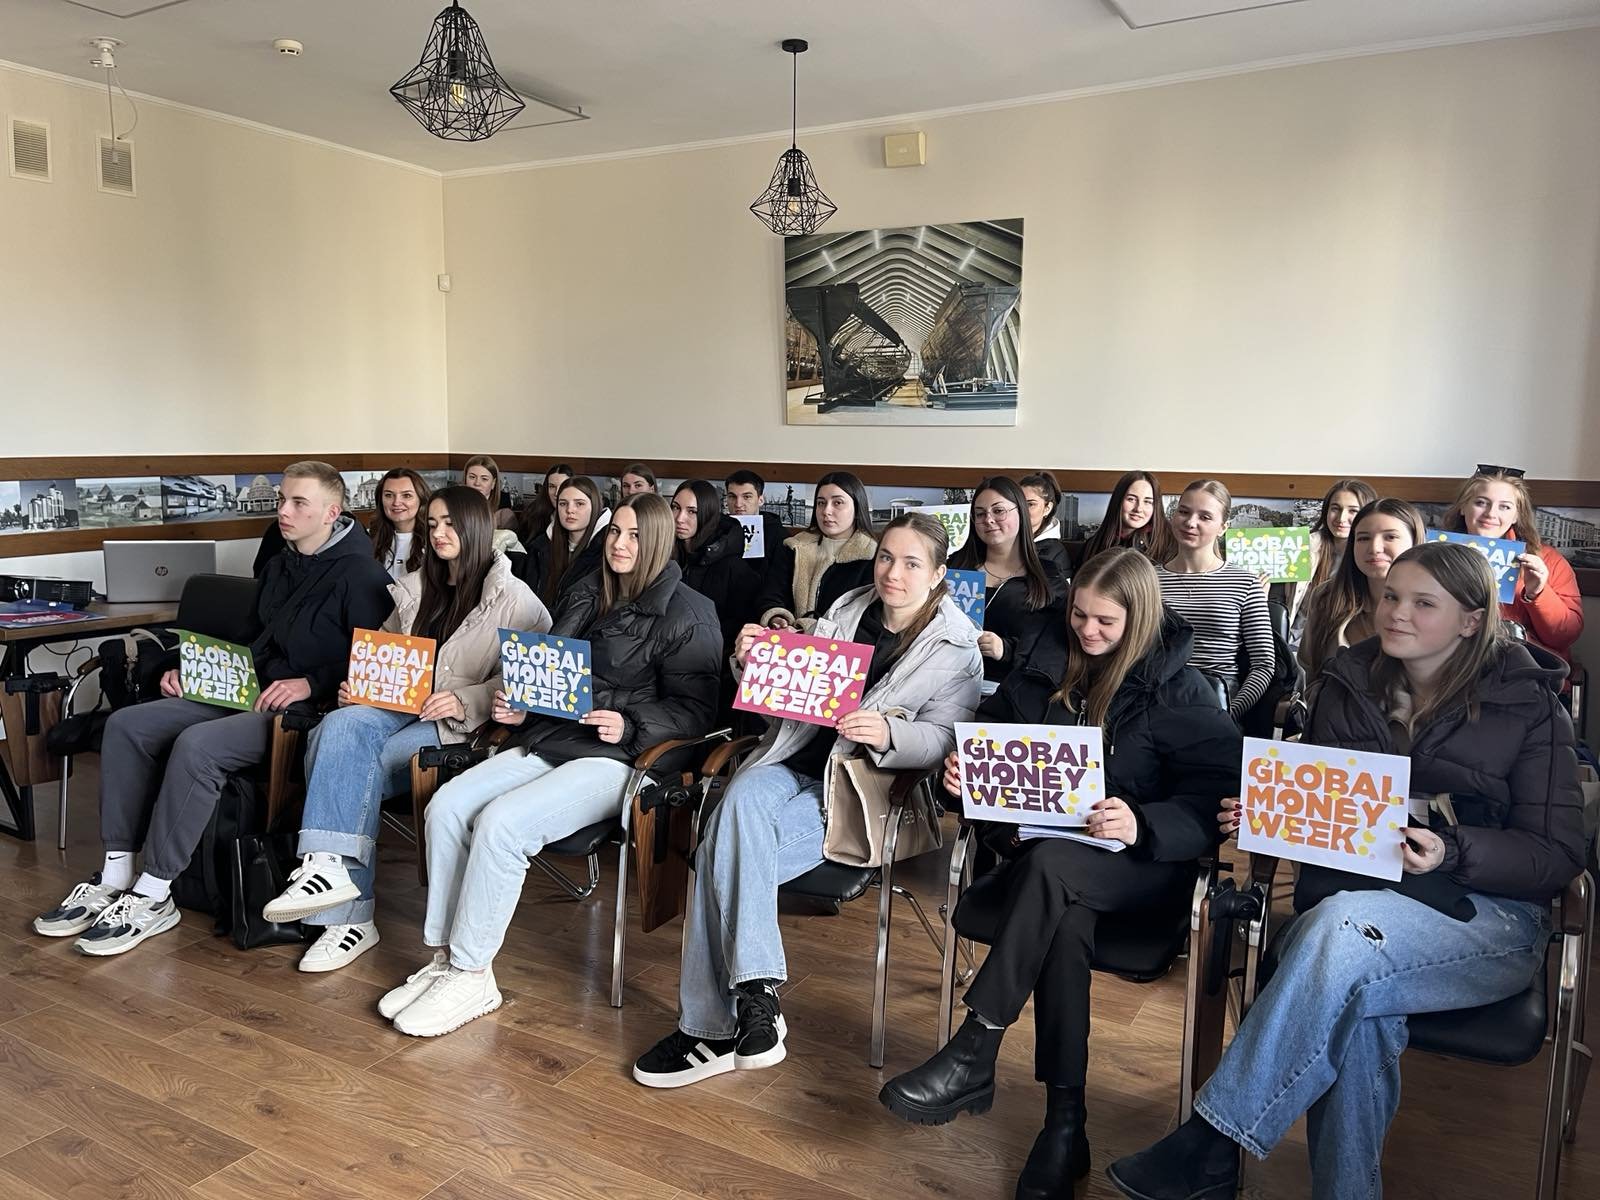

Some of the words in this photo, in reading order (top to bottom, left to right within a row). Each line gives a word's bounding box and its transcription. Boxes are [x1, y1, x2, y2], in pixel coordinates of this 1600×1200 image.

[1227, 536, 1309, 552] GLOBAL
[1227, 551, 1302, 565] MONEY
[181, 642, 255, 673] GLOBAL
[352, 641, 433, 671] GLOBAL
[502, 641, 590, 675] GLOBAL
[750, 642, 866, 681] GLOBAL
[181, 660, 249, 686] MONEY
[350, 660, 425, 687] MONEY
[503, 660, 582, 692] MONEY
[744, 662, 853, 697] MONEY
[181, 675, 240, 703] WEEK
[348, 678, 409, 705] WEEK
[503, 680, 568, 711] WEEK
[741, 681, 829, 717] WEEK
[963, 738, 1100, 768] GLOBAL
[965, 762, 1087, 791] MONEY
[1248, 758, 1404, 805] GLOBAL
[966, 783, 1066, 814] WEEK
[1247, 784, 1388, 828] MONEY
[1246, 809, 1359, 854] WEEK
